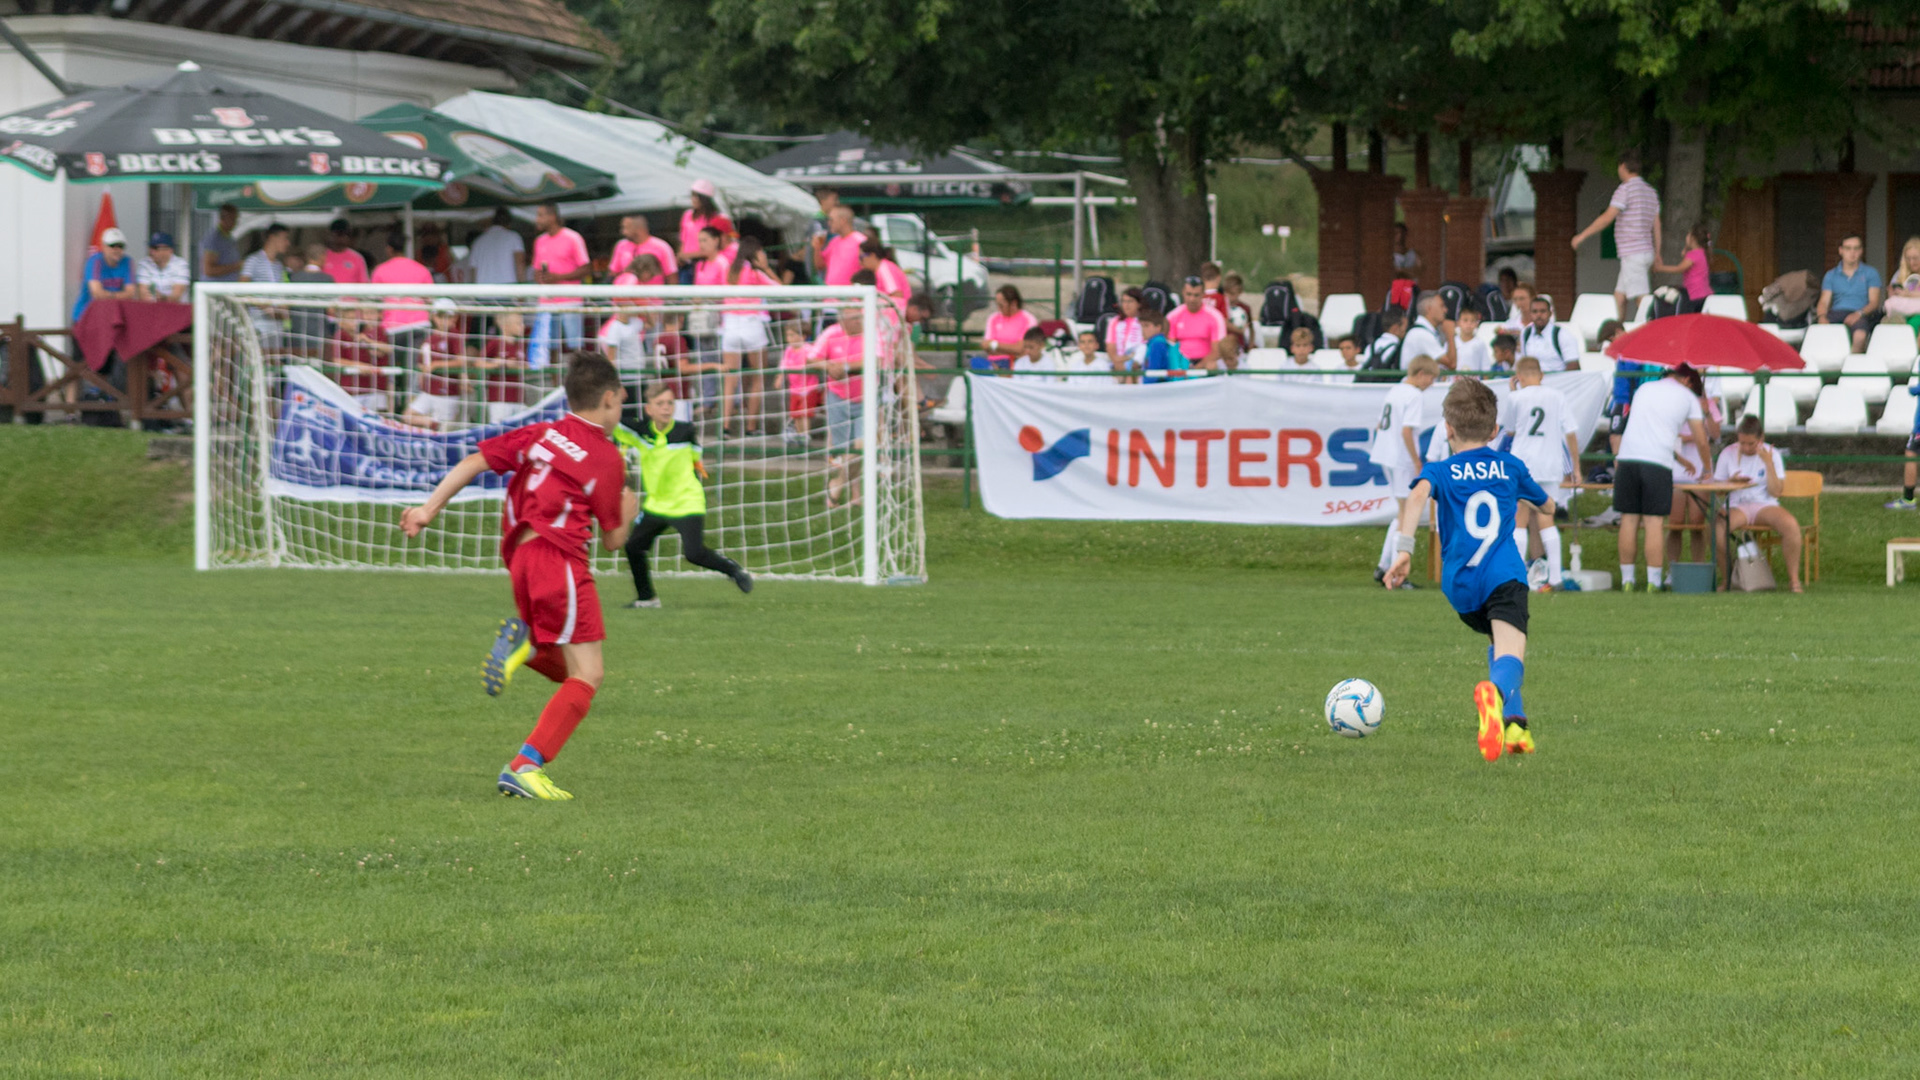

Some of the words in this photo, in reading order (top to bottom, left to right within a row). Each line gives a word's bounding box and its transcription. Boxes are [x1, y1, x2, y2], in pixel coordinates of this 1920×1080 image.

[153, 126, 343, 147] BECK'S
[118, 150, 222, 173] BECK'S
[342, 154, 441, 177] BECK'S
[912, 181, 993, 198] BECKS
[1528, 406, 1546, 437] 2
[1106, 428, 1437, 488] INTERS
[1449, 460, 1510, 480] SASAL
[1321, 496, 1390, 515] SPORT
[1464, 489, 1501, 568] 9
